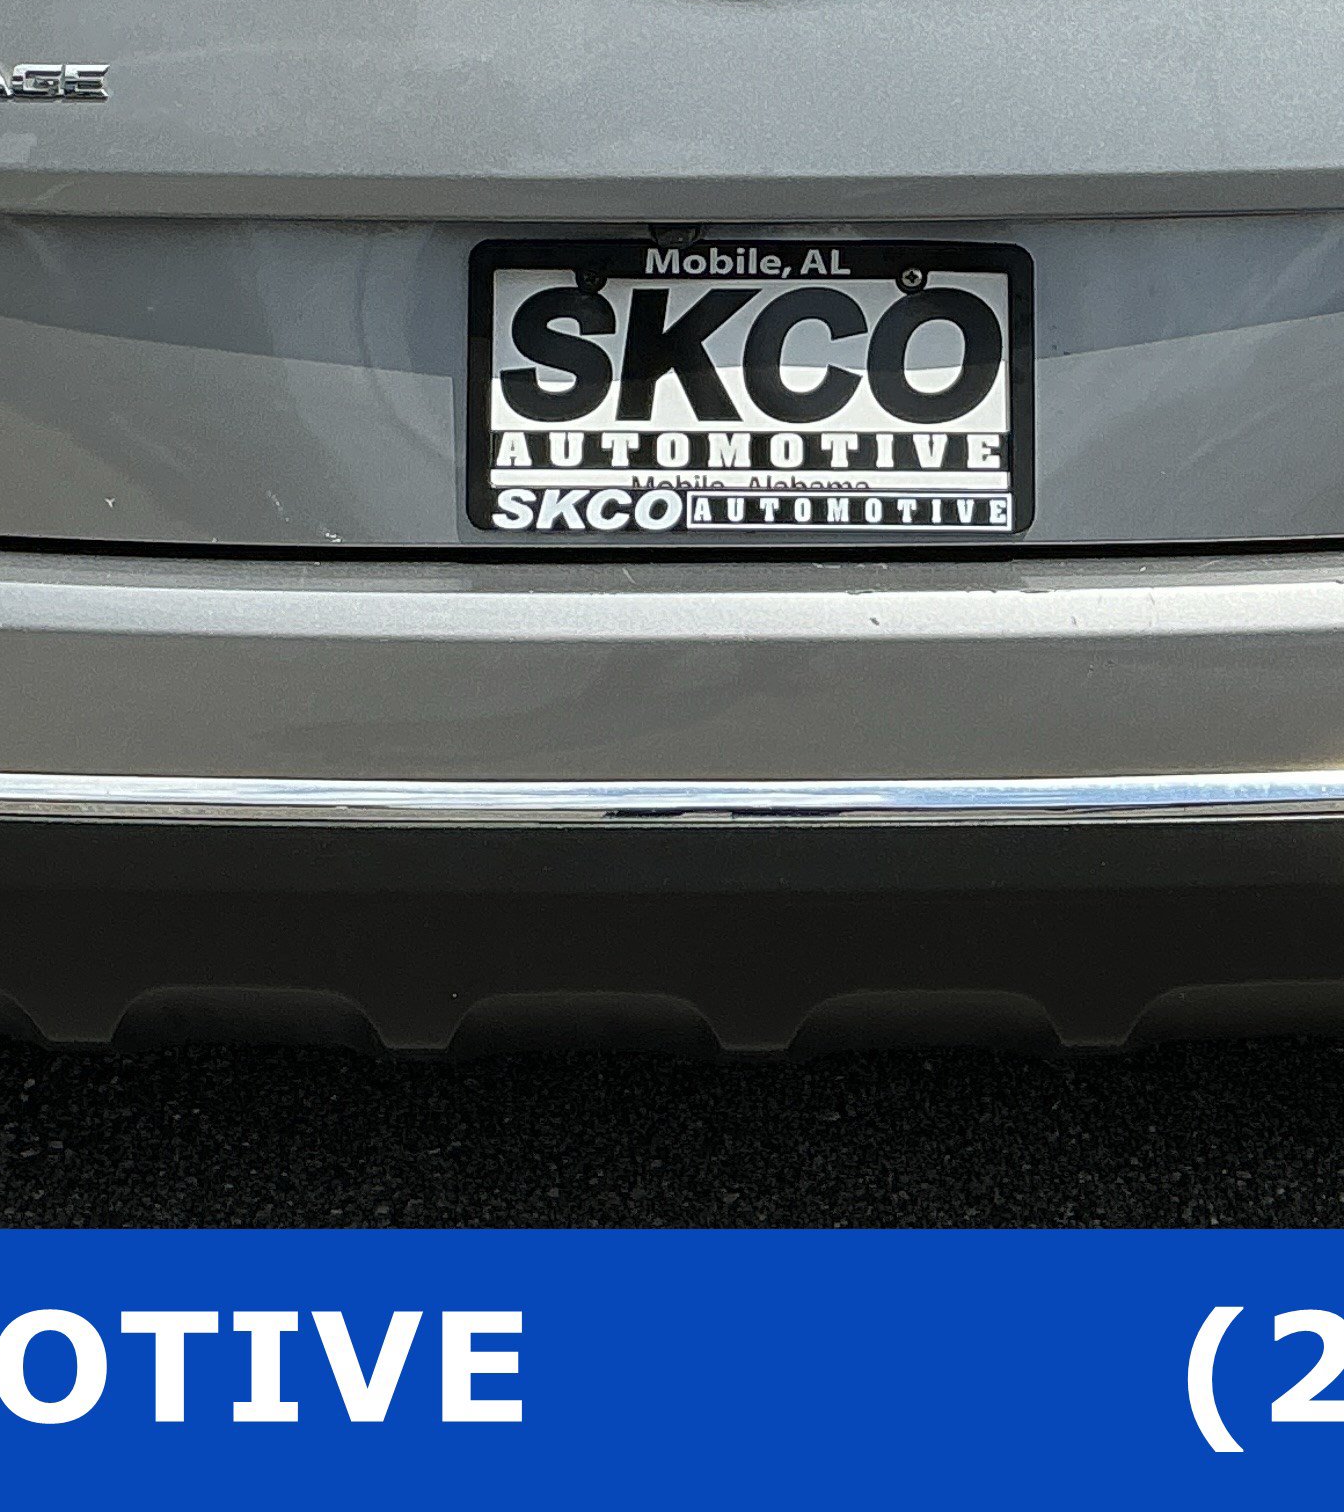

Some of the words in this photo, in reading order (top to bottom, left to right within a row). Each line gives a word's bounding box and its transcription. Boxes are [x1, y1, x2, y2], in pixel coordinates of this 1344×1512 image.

[645, 248, 791, 278] Mobile,
[799, 249, 851, 275] AL
[500, 287, 1003, 424] SKCO
[496, 432, 1002, 469] AUTOMOTIVE
[492, 488, 683, 530] SKCO
[692, 496, 1008, 525] AUTOMOTIVE
